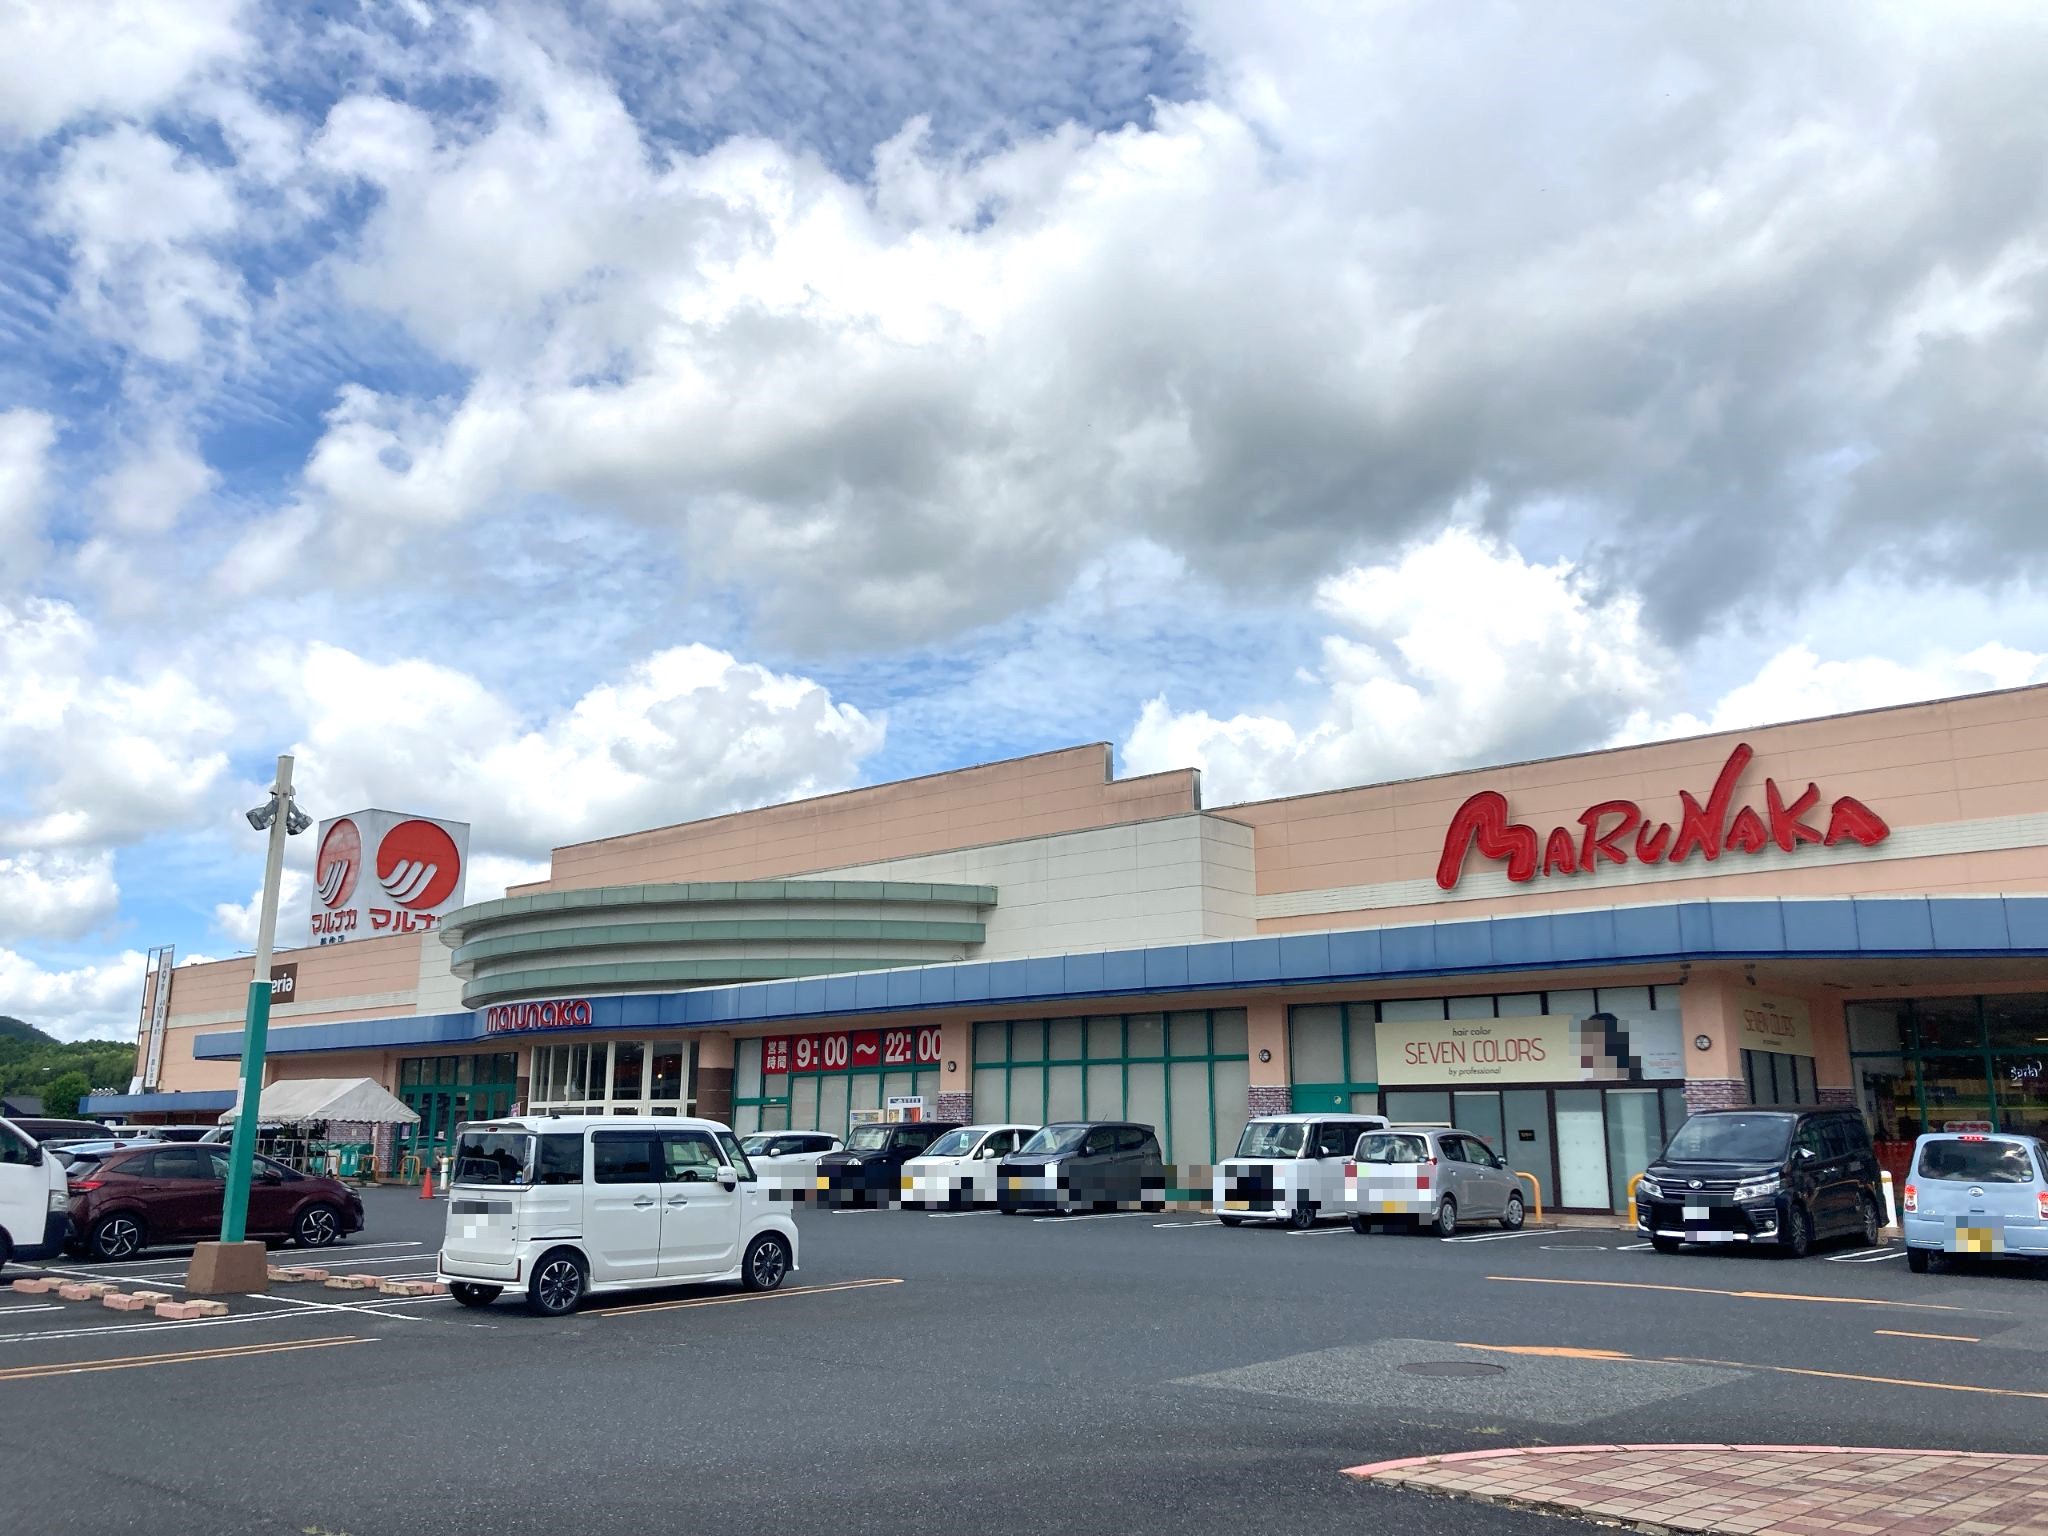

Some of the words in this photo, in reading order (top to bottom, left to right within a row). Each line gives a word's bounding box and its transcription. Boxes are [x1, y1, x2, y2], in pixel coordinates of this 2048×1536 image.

[1436, 742, 1891, 890] MARUNAKA
[312, 908, 358, 935] マルナカ
[369, 908, 441, 933] マルナ
[271, 972, 294, 994] eria
[487, 1000, 593, 1033] marunaka
[1452, 1027, 1469, 1037] hair
[1470, 1026, 1492, 1036] color
[1405, 1041, 1466, 1065] SEVEN
[1473, 1038, 1546, 1063] COLORS
[1448, 1068, 1457, 1077] by
[1459, 1067, 1501, 1077] professional
